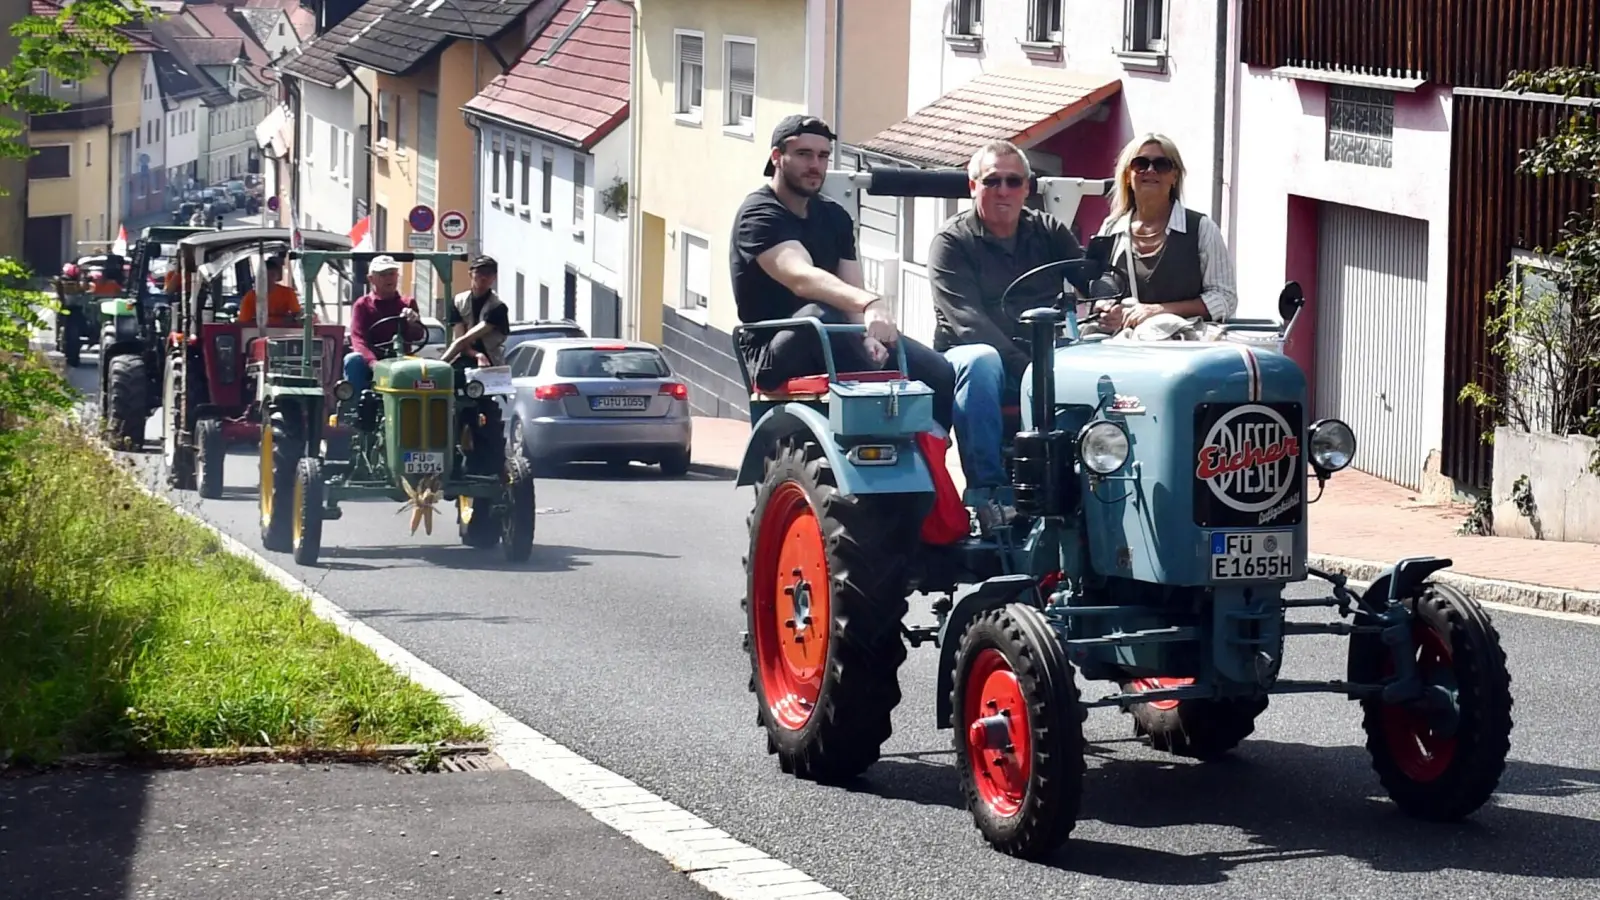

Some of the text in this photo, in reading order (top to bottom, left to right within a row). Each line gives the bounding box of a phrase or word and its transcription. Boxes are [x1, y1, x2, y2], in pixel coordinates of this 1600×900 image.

[407, 463, 414, 472] D
[1196, 436, 1299, 480] Eicher
[1226, 535, 1252, 555] FÜ
[1215, 555, 1291, 577] E1655H
